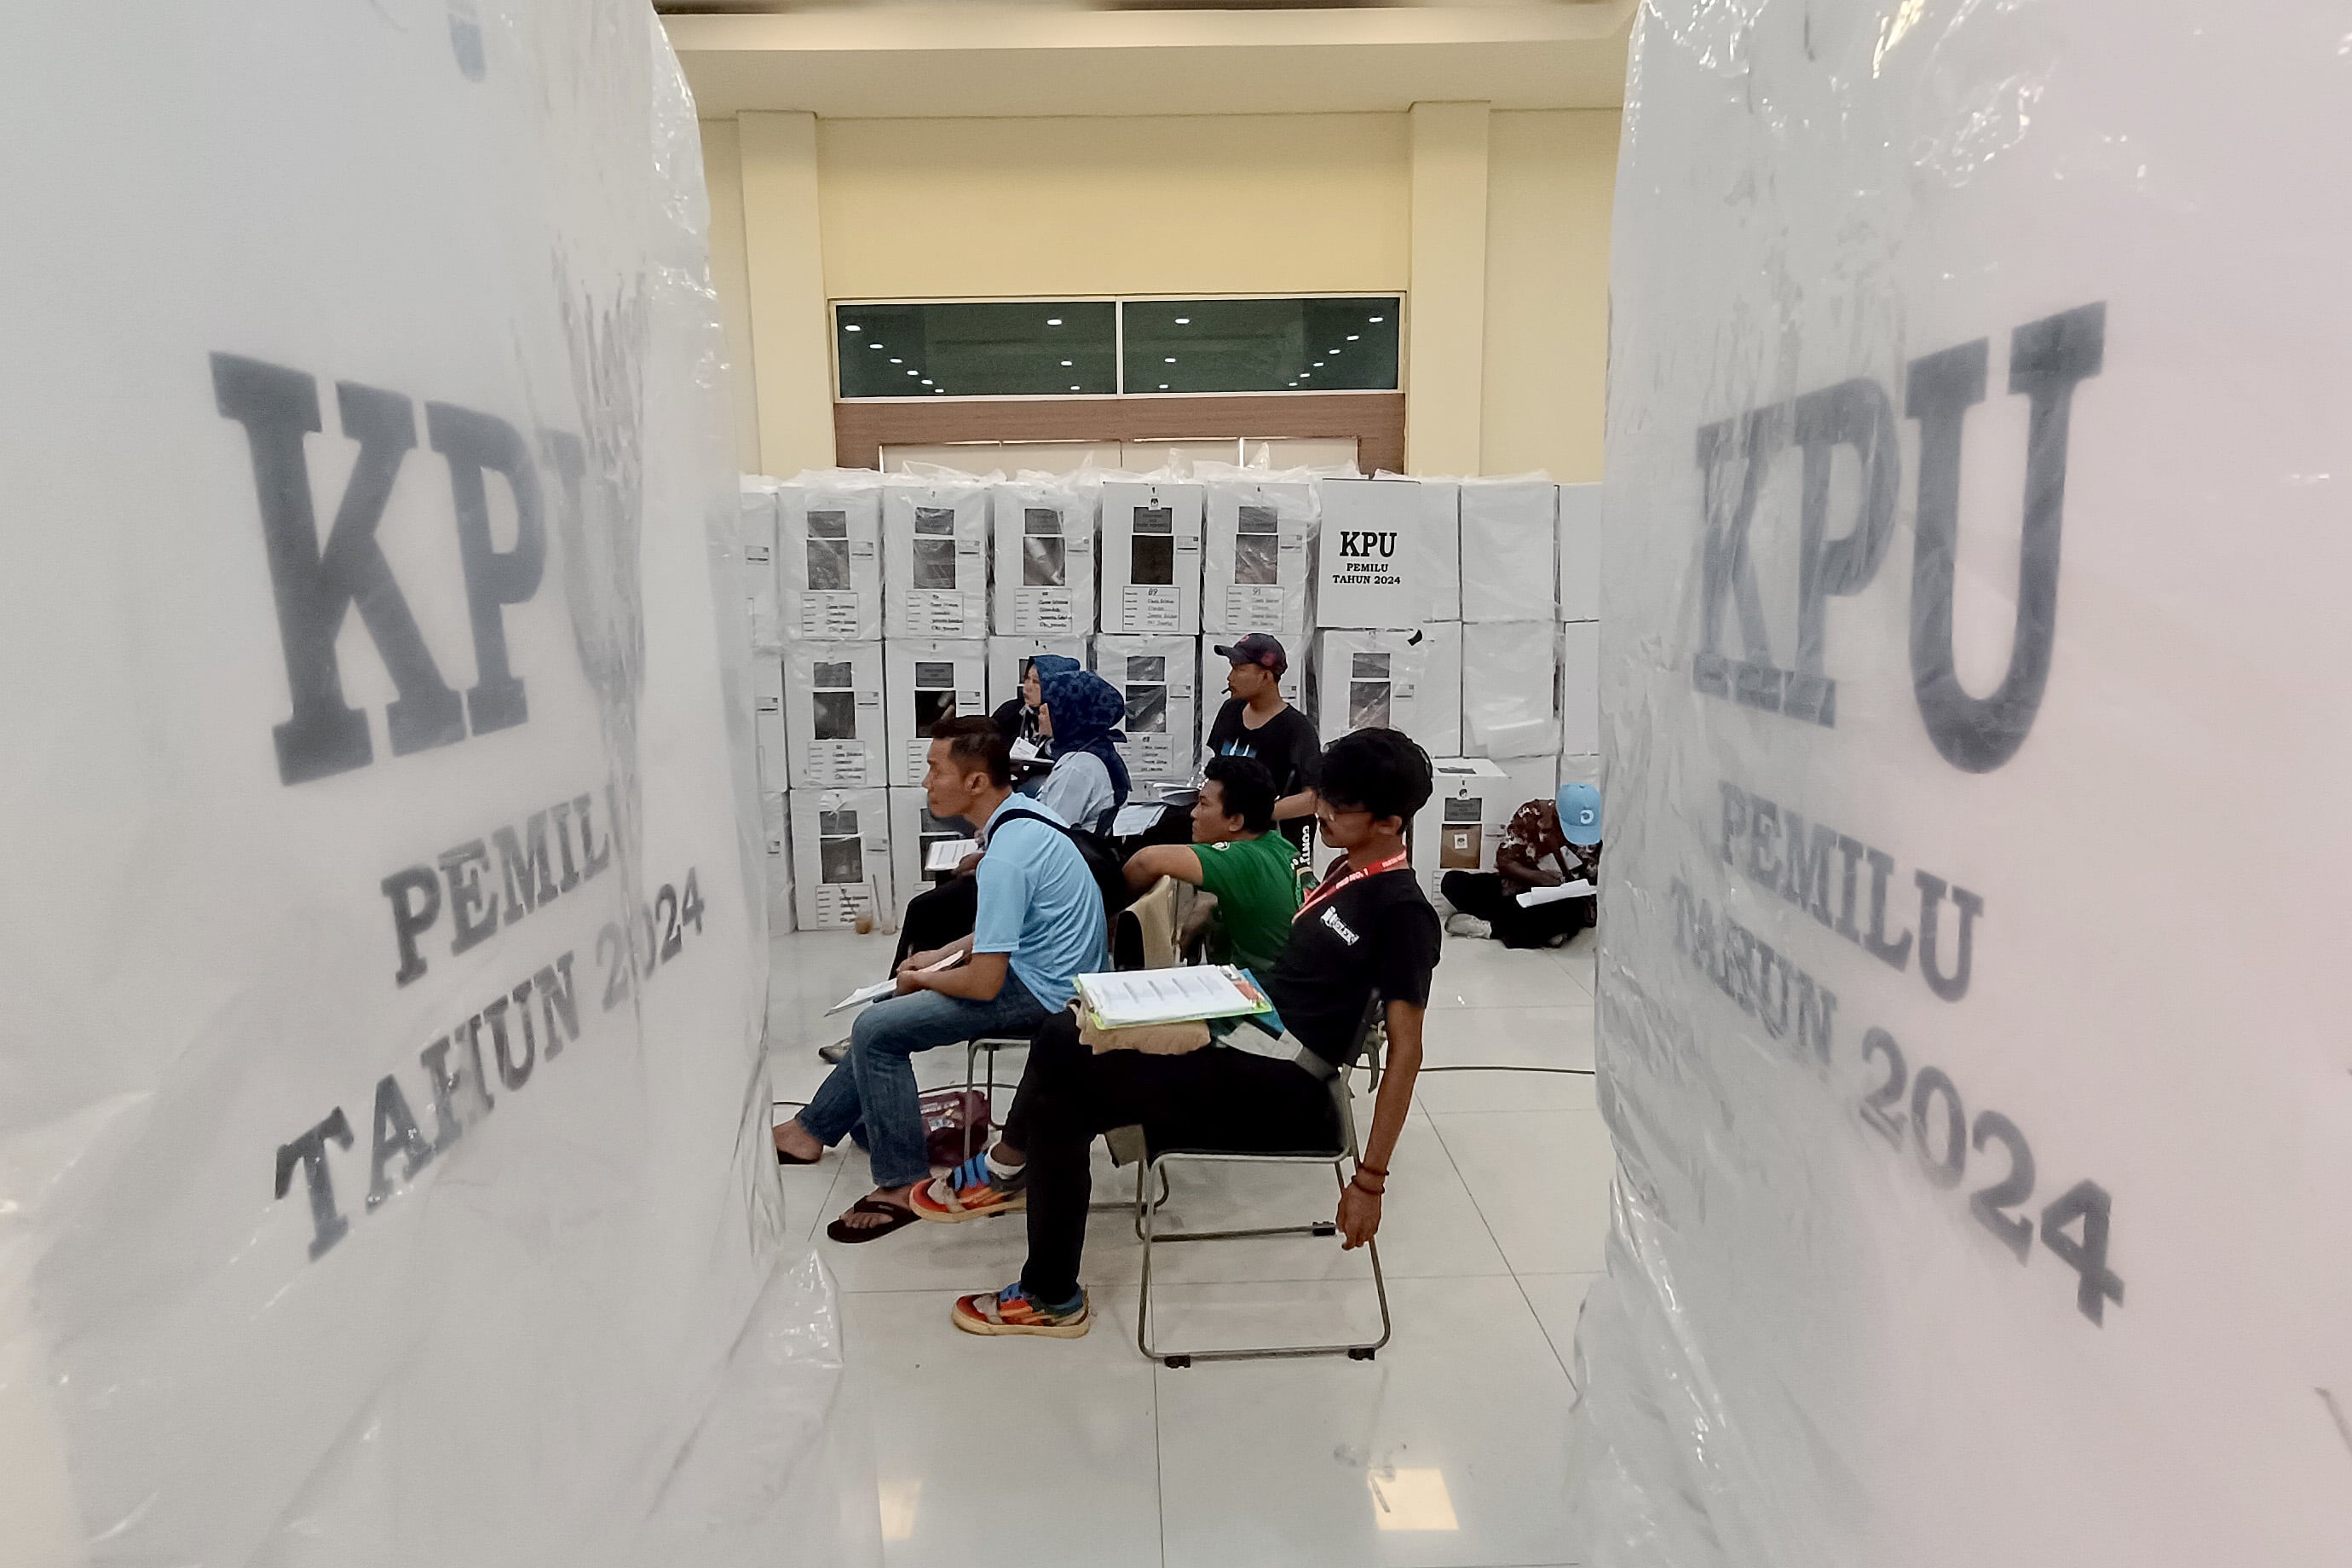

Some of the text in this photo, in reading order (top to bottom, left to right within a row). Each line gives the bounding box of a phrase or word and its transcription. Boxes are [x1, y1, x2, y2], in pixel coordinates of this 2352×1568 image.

[1332, 574, 1401, 585] TAHUN 2024
[1340, 531, 1398, 557] KPU
[1346, 562, 1389, 573] PEMILU
[1692, 300, 2107, 775] KPU
[1718, 779, 1984, 1003] PEMILU
[275, 949, 581, 1263] TAHUN
[1859, 1026, 2125, 1329] 2024
